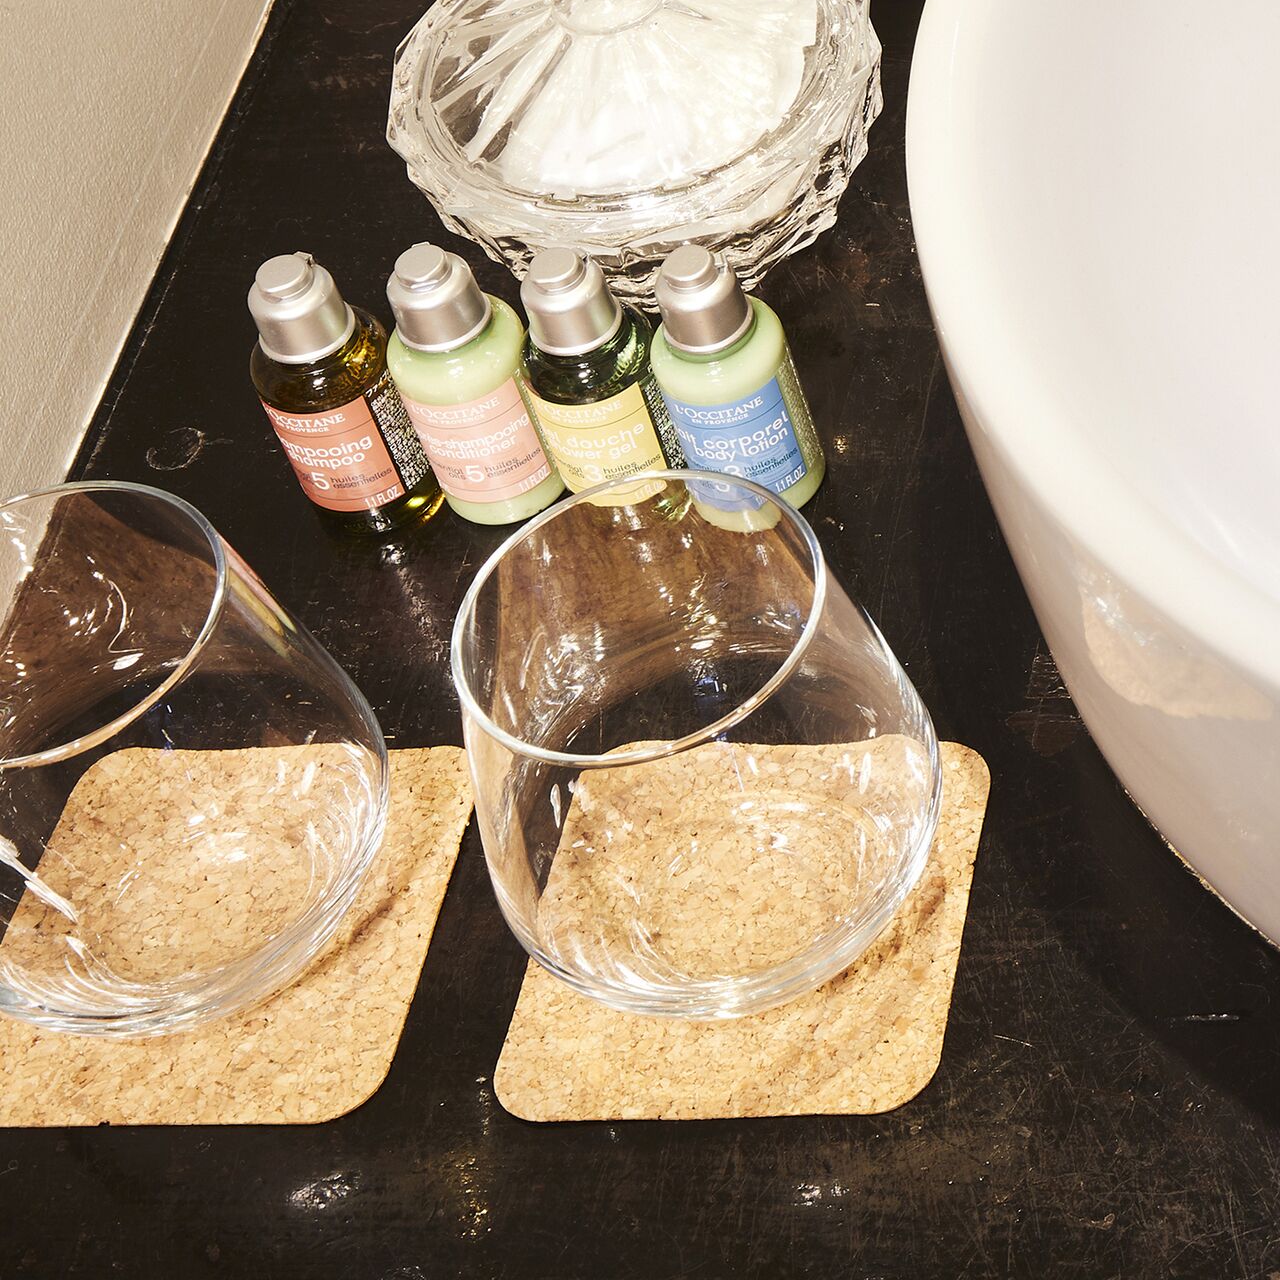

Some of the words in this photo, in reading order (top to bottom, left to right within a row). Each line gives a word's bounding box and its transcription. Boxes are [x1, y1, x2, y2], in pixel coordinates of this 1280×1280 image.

[674, 395, 764, 420] L'OCCITANE
[566, 423, 645, 449] douche
[703, 410, 789, 450] corporel
[429, 435, 517, 460] conditioner
[608, 432, 638, 460] gel
[694, 444, 736, 462] body
[739, 428, 788, 457] lotion
[465, 465, 485, 483] 5
[484, 456, 519, 473] huiles
[585, 464, 602, 482] 3
[602, 460, 637, 475] huiles
[743, 456, 777, 473] huiles
[311, 471, 331, 491] 5
[330, 473, 366, 484] huiles
